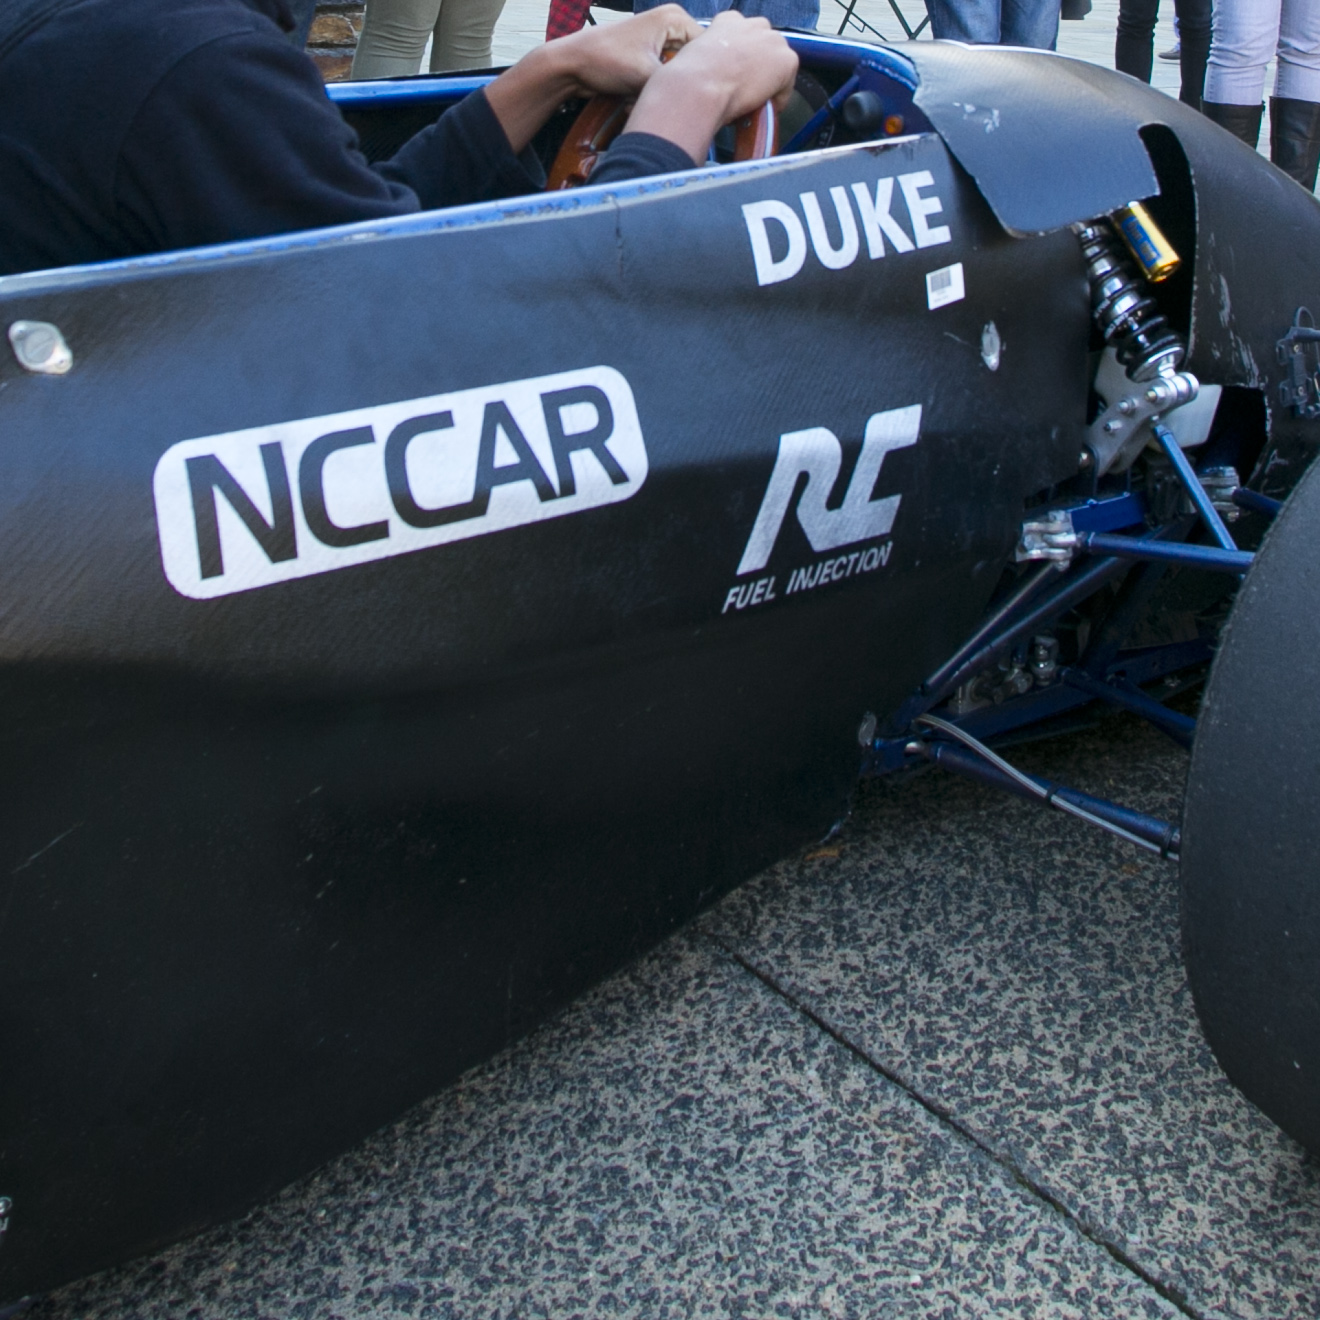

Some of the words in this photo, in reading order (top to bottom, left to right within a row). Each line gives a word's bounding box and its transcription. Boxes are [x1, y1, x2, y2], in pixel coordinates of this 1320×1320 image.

[741, 170, 952, 287] DUKE
[184, 384, 630, 581] NCCAR
[721, 576, 777, 614] FUEL
[785, 541, 893, 595] INJECTION
